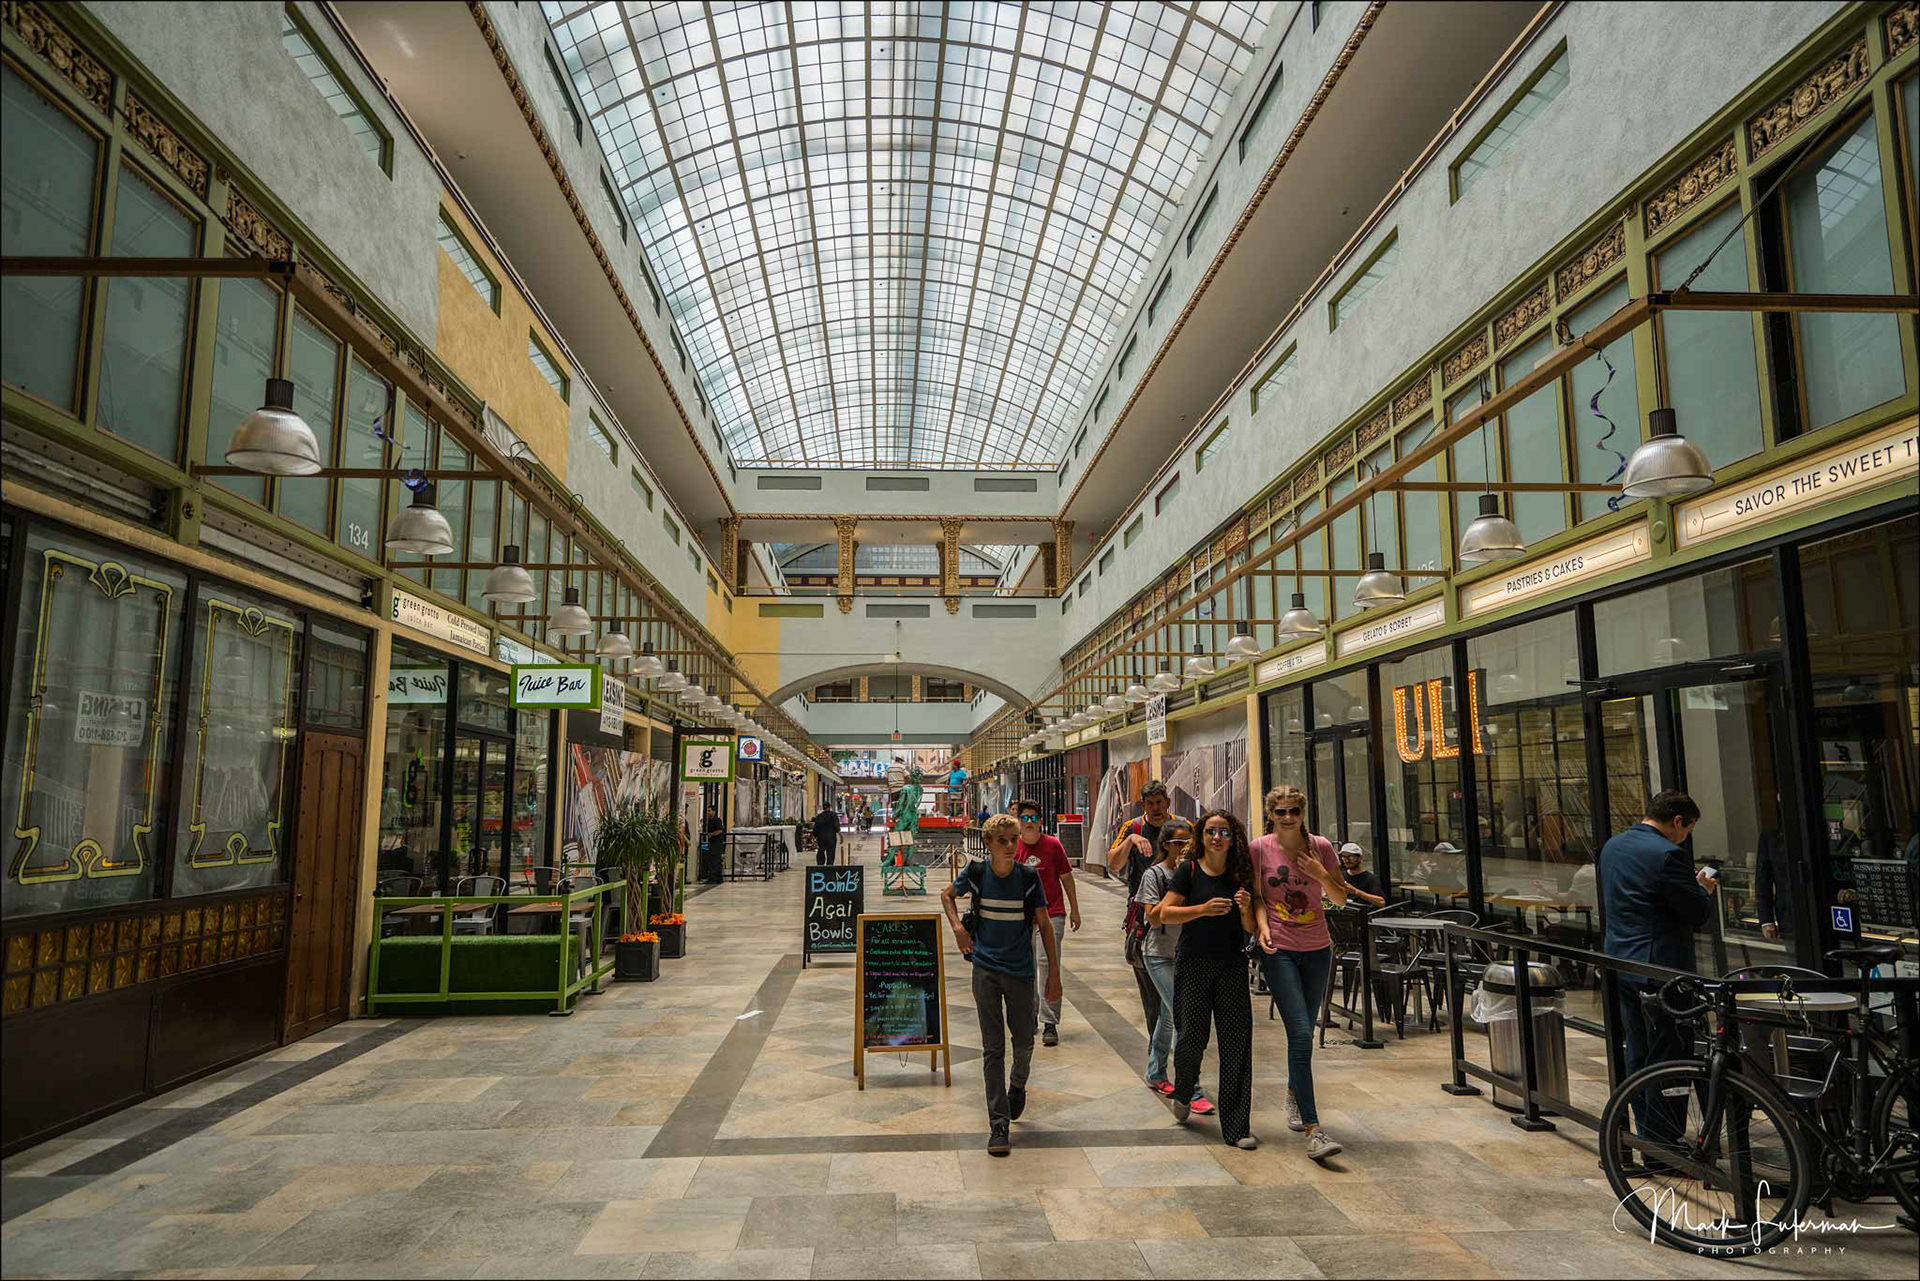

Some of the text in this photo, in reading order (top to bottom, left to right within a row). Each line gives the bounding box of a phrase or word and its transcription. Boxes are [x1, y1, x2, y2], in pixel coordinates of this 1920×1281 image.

[1734, 484, 1786, 517] SAVOR
[1791, 470, 1822, 496] THE
[1828, 445, 1894, 484] SWEET
[348, 522, 369, 550] 134
[1506, 556, 1584, 594] PASTRIES & CAKES
[402, 598, 440, 619] green grotto
[447, 613, 460, 627] Cold
[460, 619, 477, 634] Pressed
[1362, 626, 1382, 642] GELATO
[1389, 615, 1412, 633] SORBET
[449, 630, 472, 646] Jamaican
[1277, 659, 1292, 671] COFFEE
[519, 674, 586, 698] Juice Bar
[1393, 668, 1482, 764] ULI
[1852, 863, 1906, 874] BUSINESS HOURS
[811, 870, 857, 893] Bomb
[809, 896, 852, 919] Açai
[809, 921, 853, 941] Bowls
[876, 922, 908, 934] CAKES
